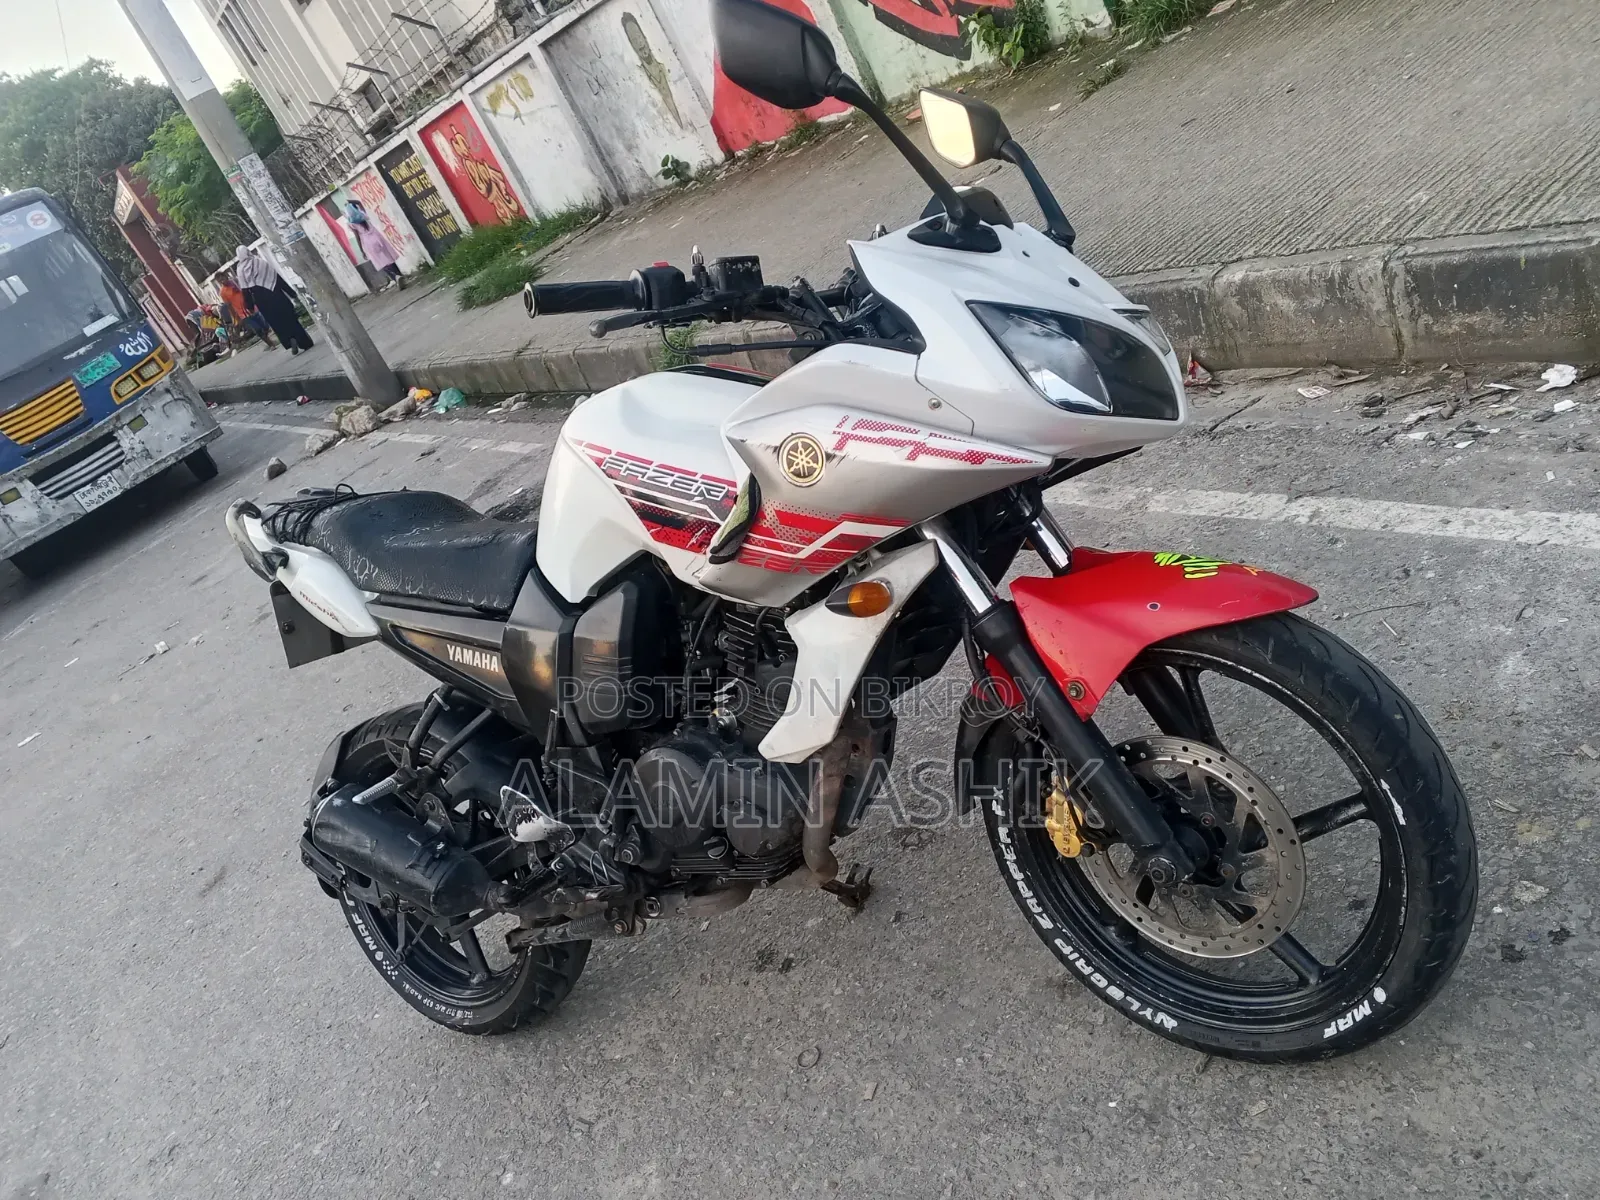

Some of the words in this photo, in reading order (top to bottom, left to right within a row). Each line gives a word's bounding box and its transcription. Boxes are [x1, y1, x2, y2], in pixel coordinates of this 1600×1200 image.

[600, 455, 729, 502] FAZER
[447, 644, 499, 673] YAMAHA
[997, 825, 1055, 930] ZAPPER
[351, 912, 378, 951] MRF
[1053, 936, 1179, 1032] NYLOGRIP
[1323, 999, 1373, 1039] MRF
